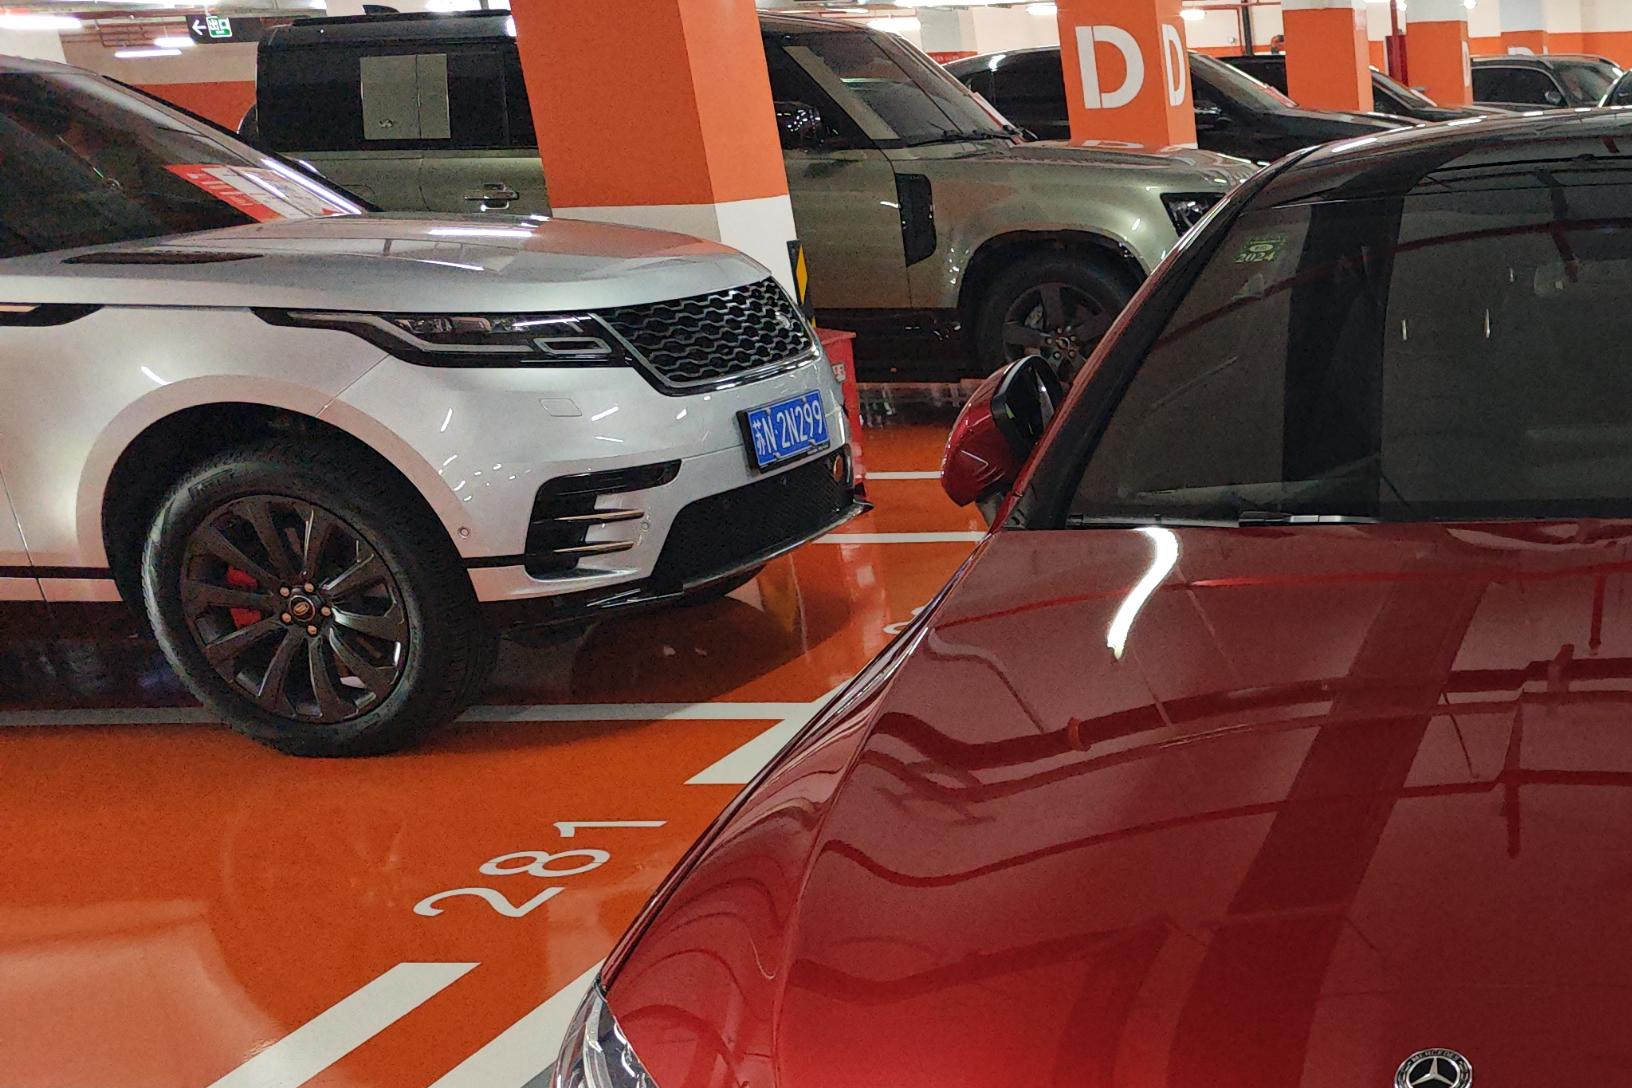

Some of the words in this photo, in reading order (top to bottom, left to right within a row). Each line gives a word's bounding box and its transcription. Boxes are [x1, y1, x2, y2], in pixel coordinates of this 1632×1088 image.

[1075, 25, 1144, 109] D
[1162, 23, 1186, 107] D
[1233, 252, 1276, 263] 2024
[413, 820, 668, 917] 281
